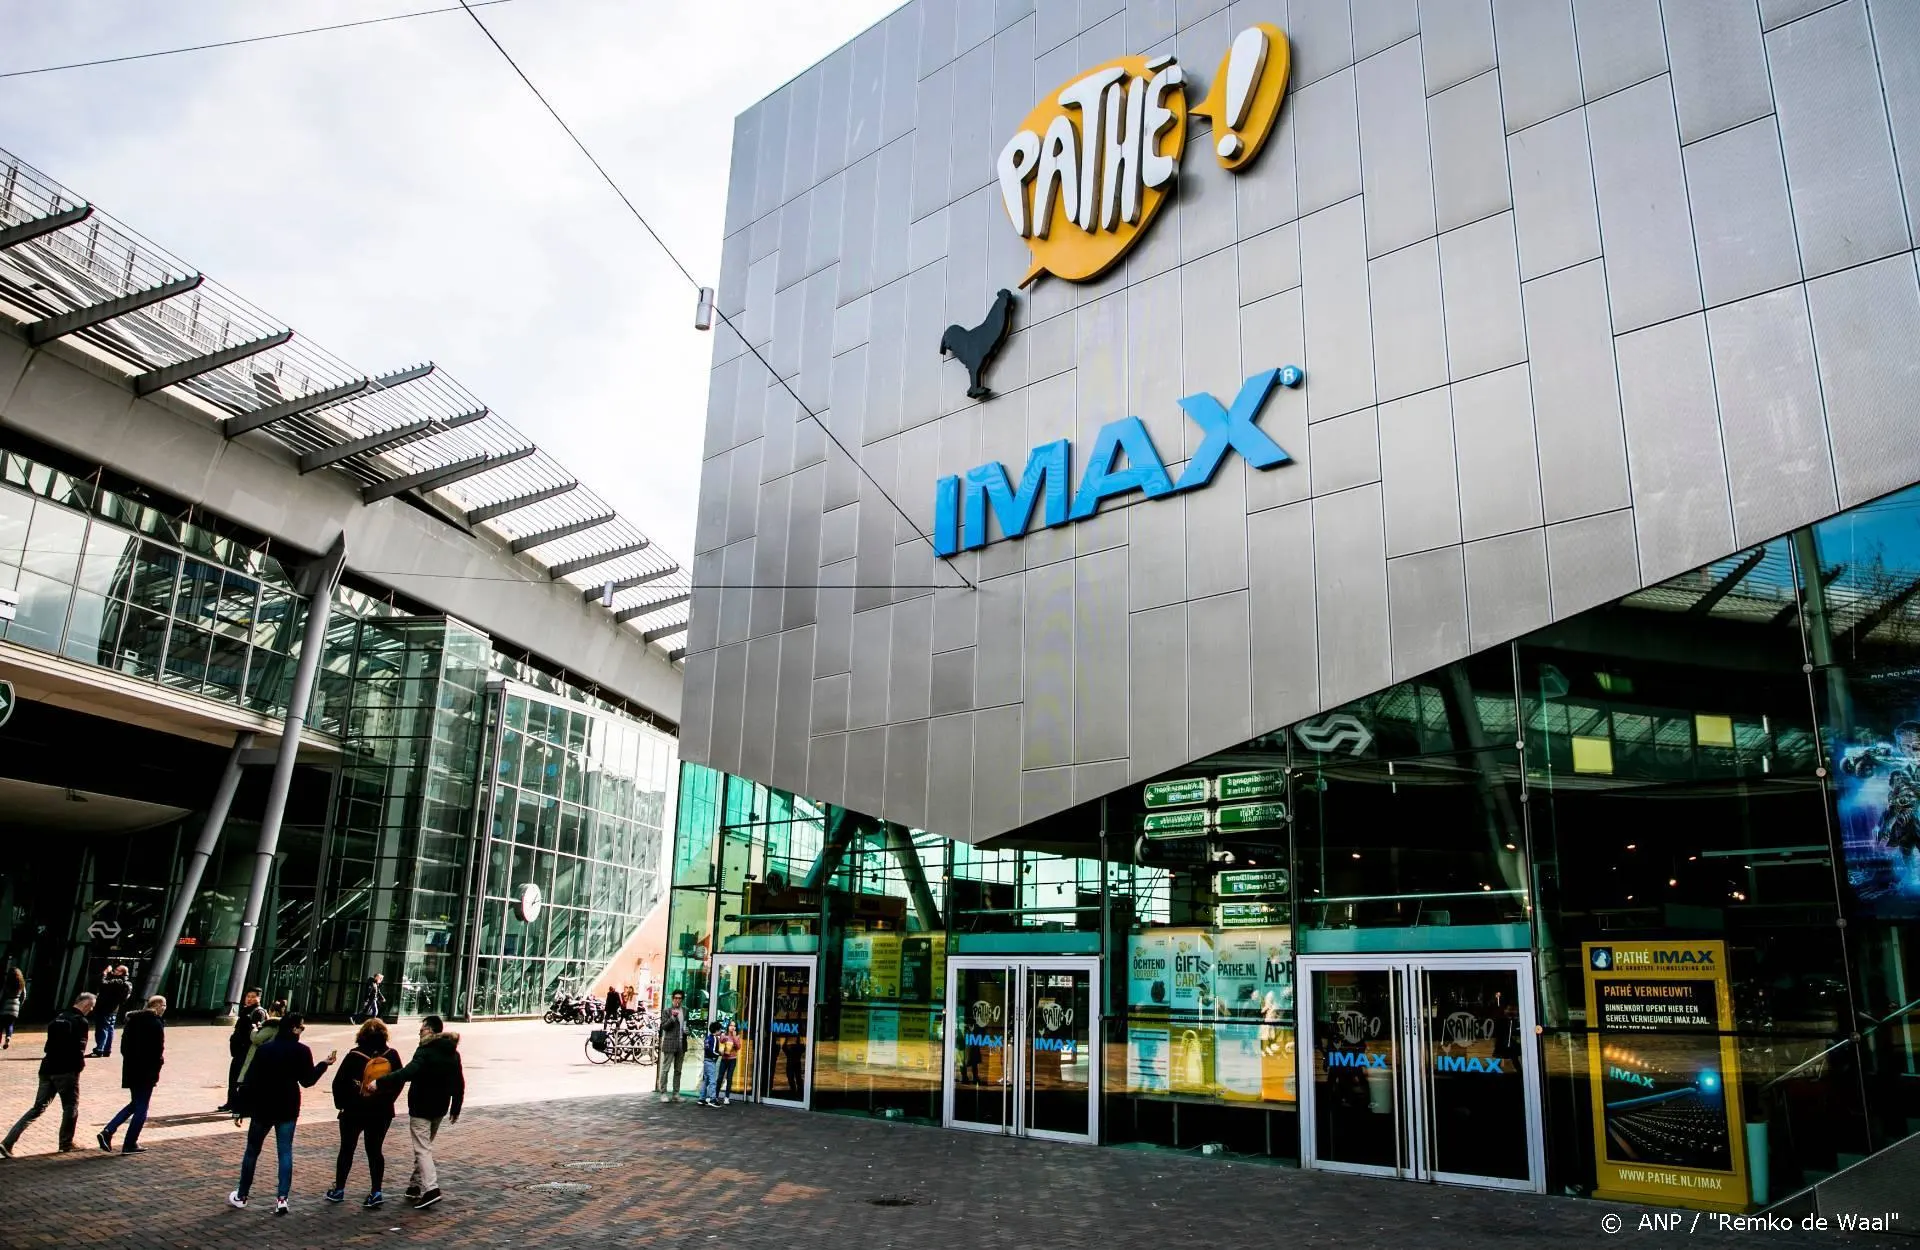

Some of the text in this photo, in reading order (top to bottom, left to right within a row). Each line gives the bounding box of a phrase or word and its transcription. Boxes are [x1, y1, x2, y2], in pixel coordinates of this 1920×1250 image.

[1615, 949, 1714, 964] PATHÉ IMAX
[1604, 984, 1692, 998] PATHÉ VERNIEUWT!
[1605, 1004, 1698, 1013] BINNENKORT OPENT HIER EEN
[1606, 1015, 1710, 1025] GEHEEL VERNIEUWDE IMAX ZAAL.
[771, 1022, 799, 1034] IMAX
[965, 1033, 1003, 1048] IMAX
[1034, 1038, 1077, 1053] IMAX
[1329, 1052, 1388, 1069] IMAX
[1437, 1055, 1504, 1073] IMAX
[1609, 1066, 1655, 1088] IMAX
[1619, 1169, 1723, 1190] WWW.PATHE.NL/IMAX
